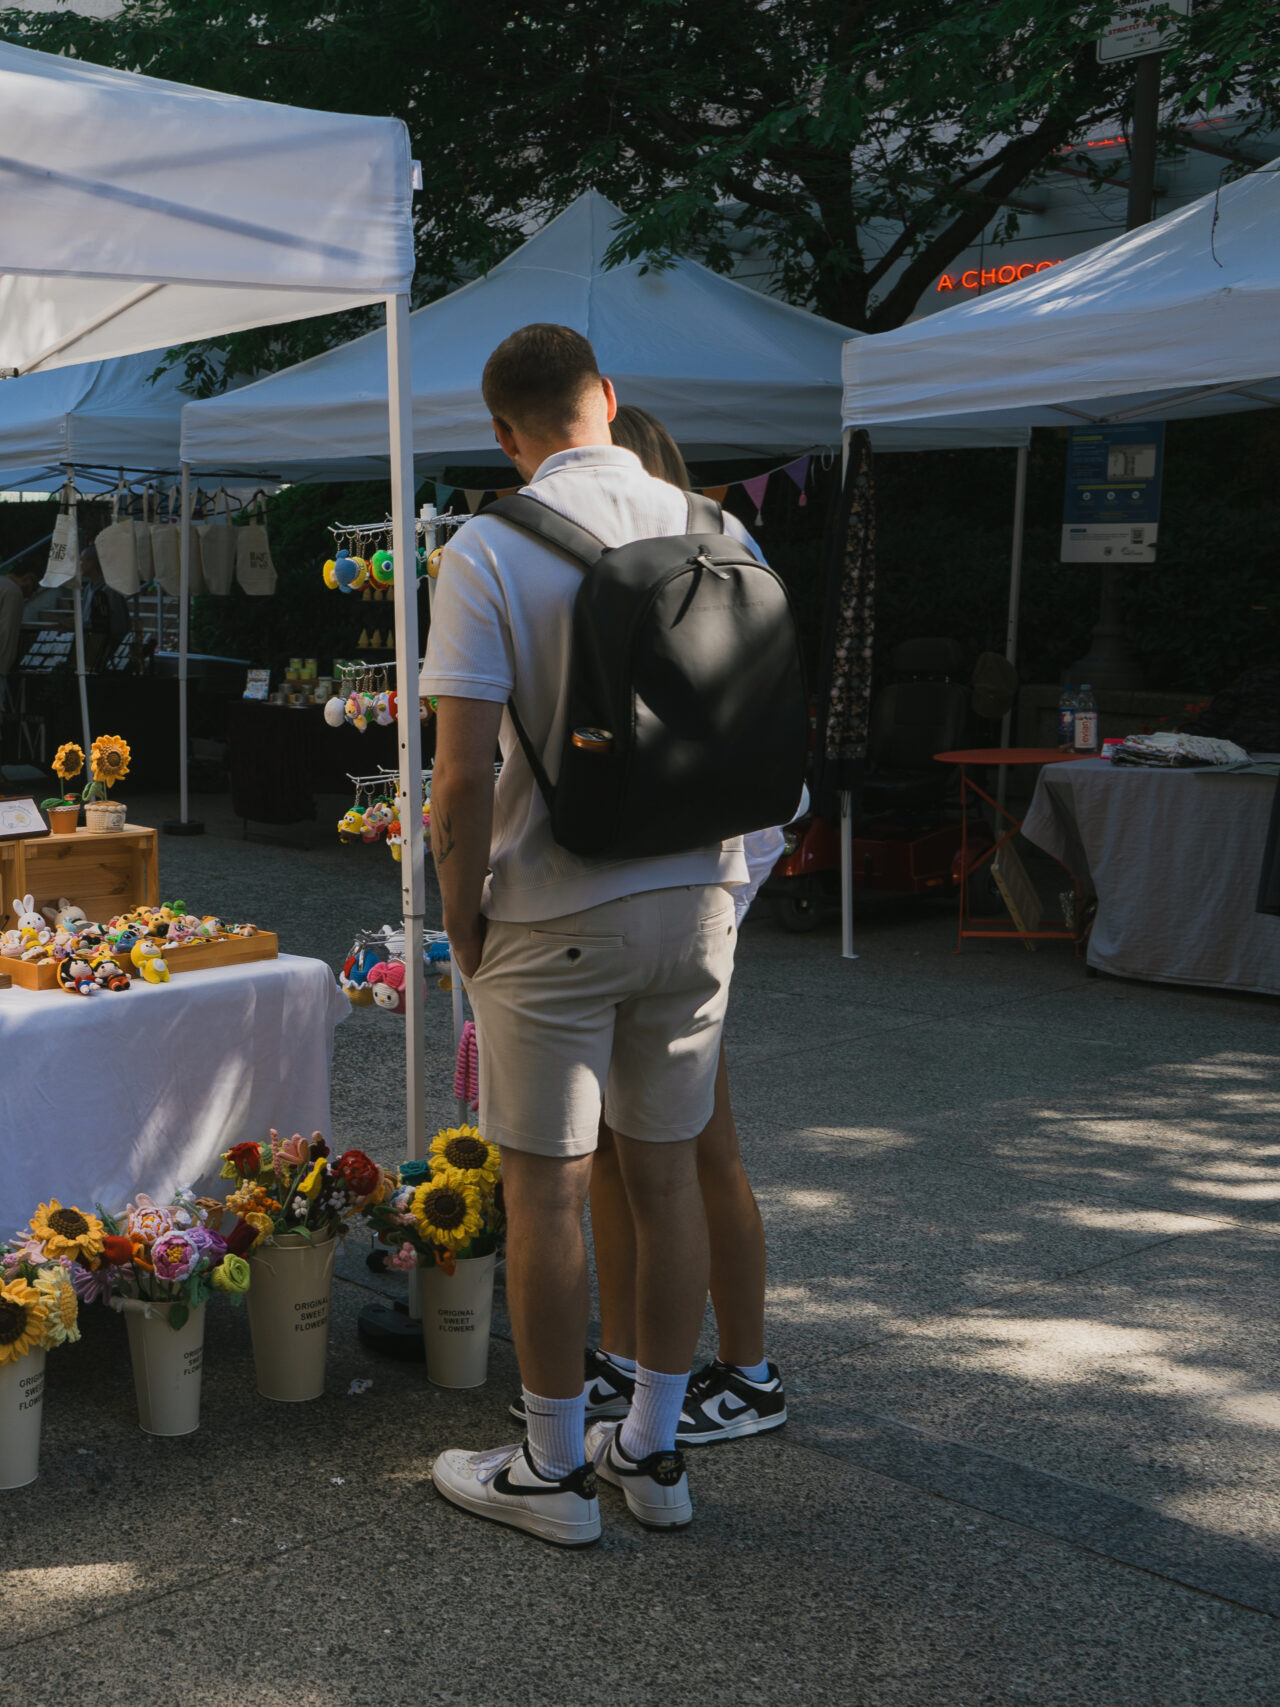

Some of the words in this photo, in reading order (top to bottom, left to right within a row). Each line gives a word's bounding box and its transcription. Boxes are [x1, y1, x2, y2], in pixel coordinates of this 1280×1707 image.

[936, 274, 953, 292] A
[961, 260, 1063, 289] CHOCO
[300, 1307, 325, 1321] SWEET
[437, 1309, 475, 1317] ORIGINAL
[439, 1325, 475, 1333] FLOWERS
